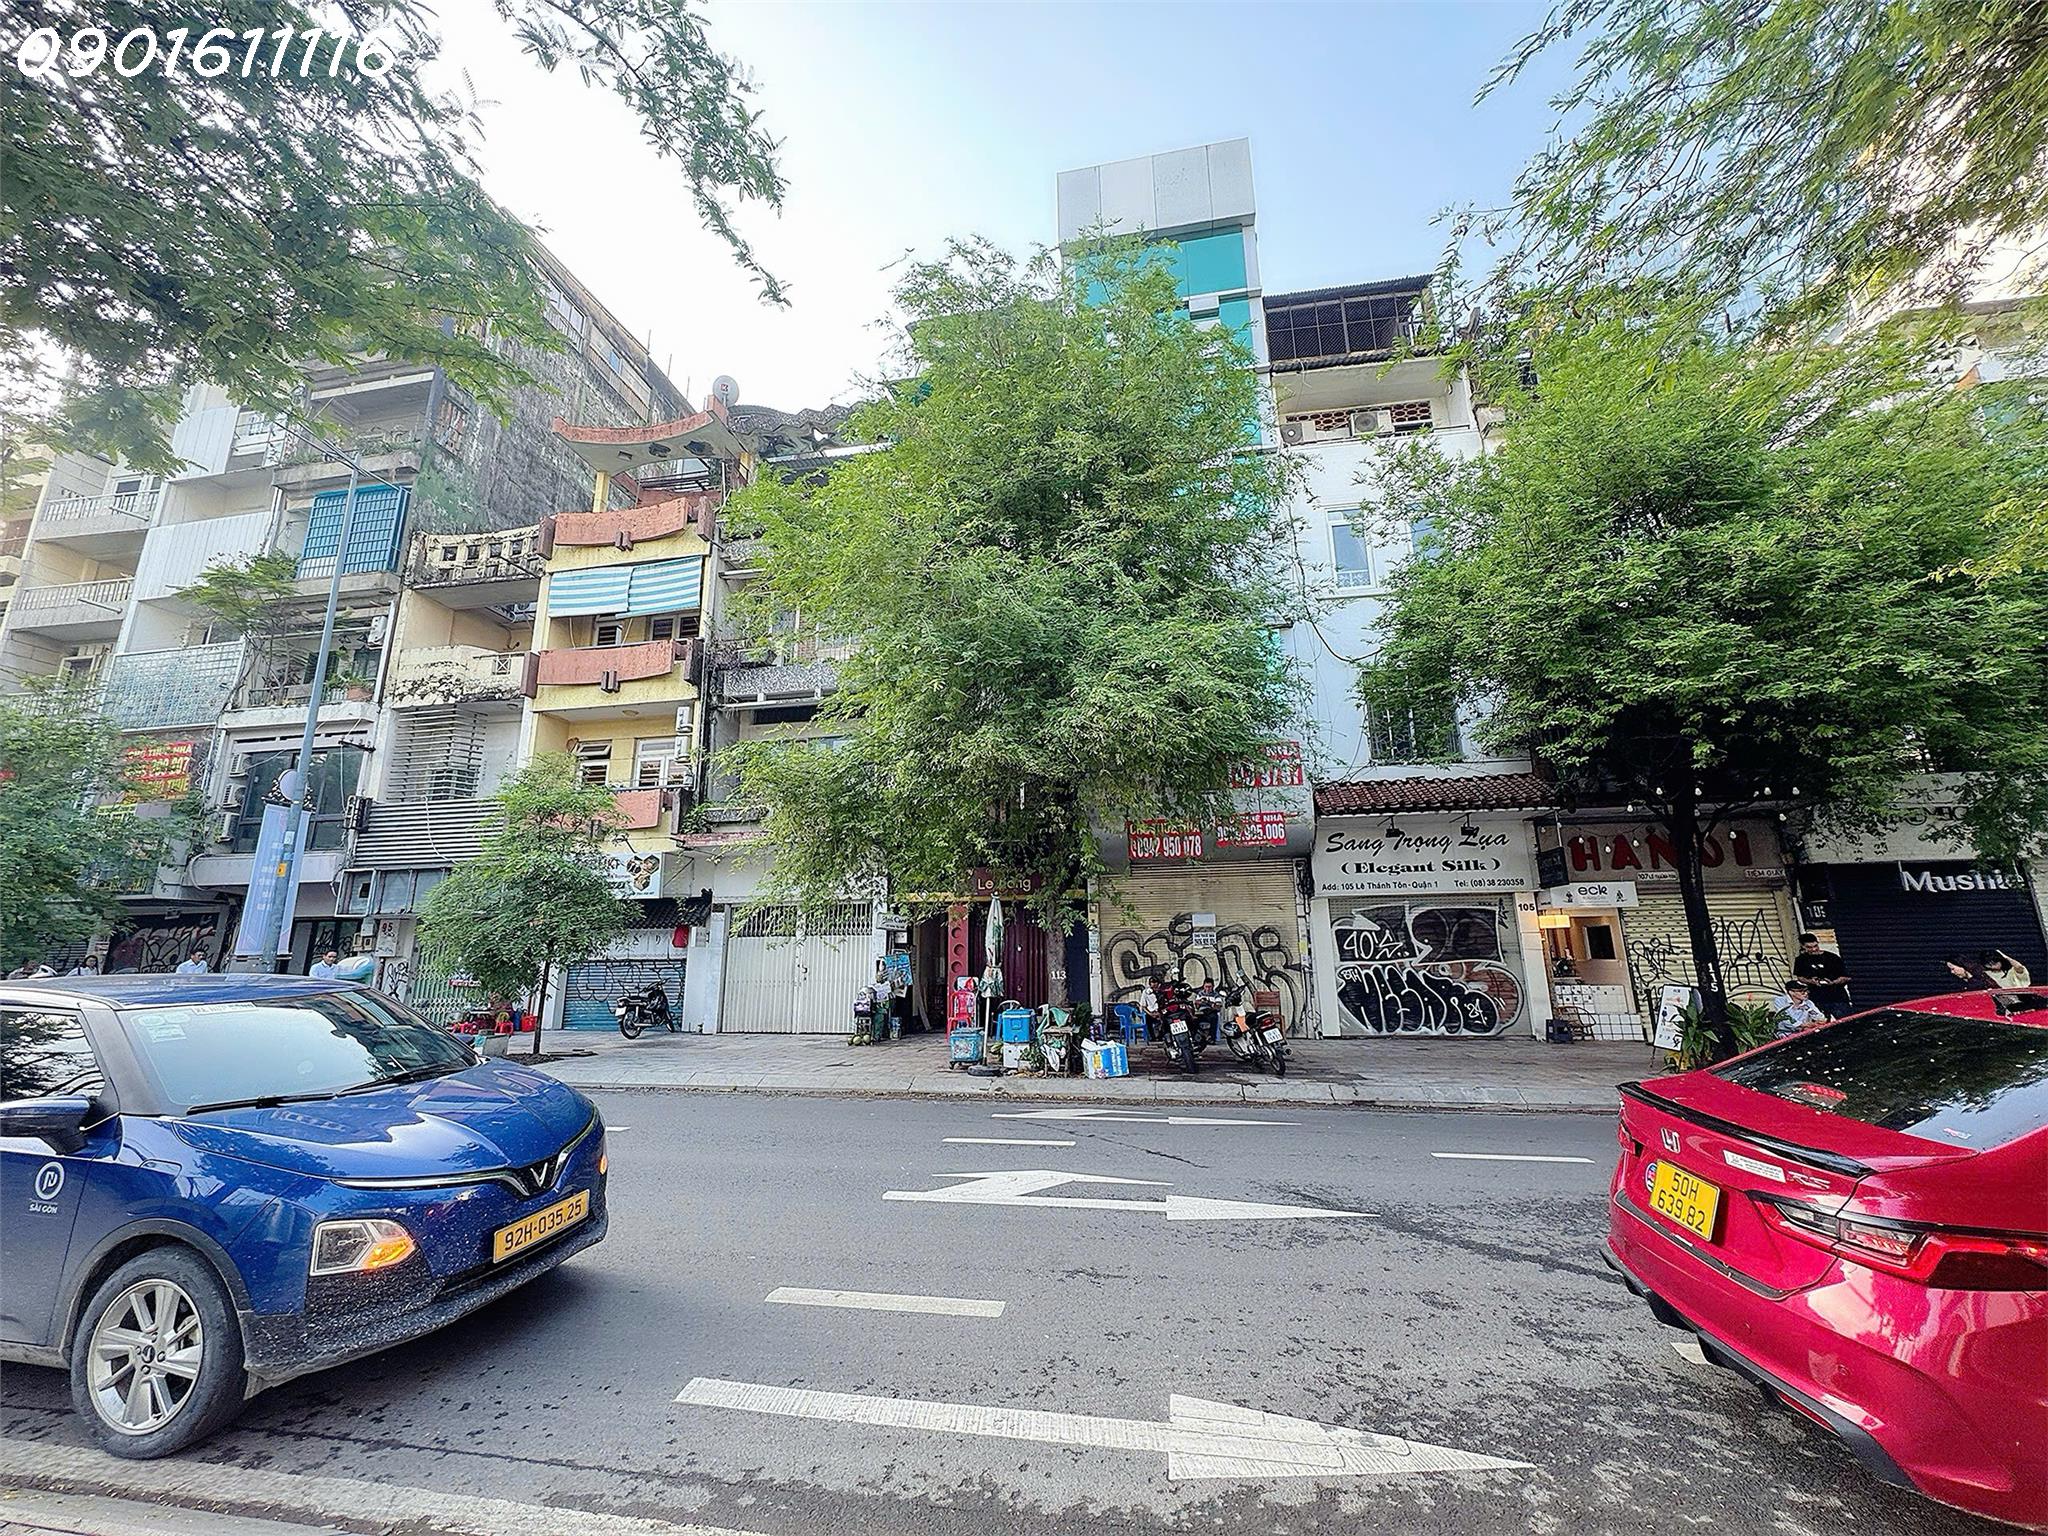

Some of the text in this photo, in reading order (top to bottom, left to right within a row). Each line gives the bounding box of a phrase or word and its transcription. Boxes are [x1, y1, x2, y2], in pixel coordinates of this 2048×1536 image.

[1163, 836, 1181, 857] 950
[1325, 832, 1385, 857] Sang
[977, 878, 995, 890] Le
[1321, 883, 1340, 891] Add:
[1355, 882, 1365, 890] Lê
[1366, 881, 1391, 890] Thánh
[1454, 879, 1469, 887] Tel:
[1497, 878, 1525, 887] 230358
[1577, 884, 1608, 896] eck
[1517, 903, 1536, 912] 105
[381, 922, 394, 933] 95
[1050, 970, 1067, 980] 113
[1671, 1172, 1700, 1202] 50H
[1657, 1188, 1706, 1233] 639.82
[504, 1198, 582, 1252] 92H-035.25
